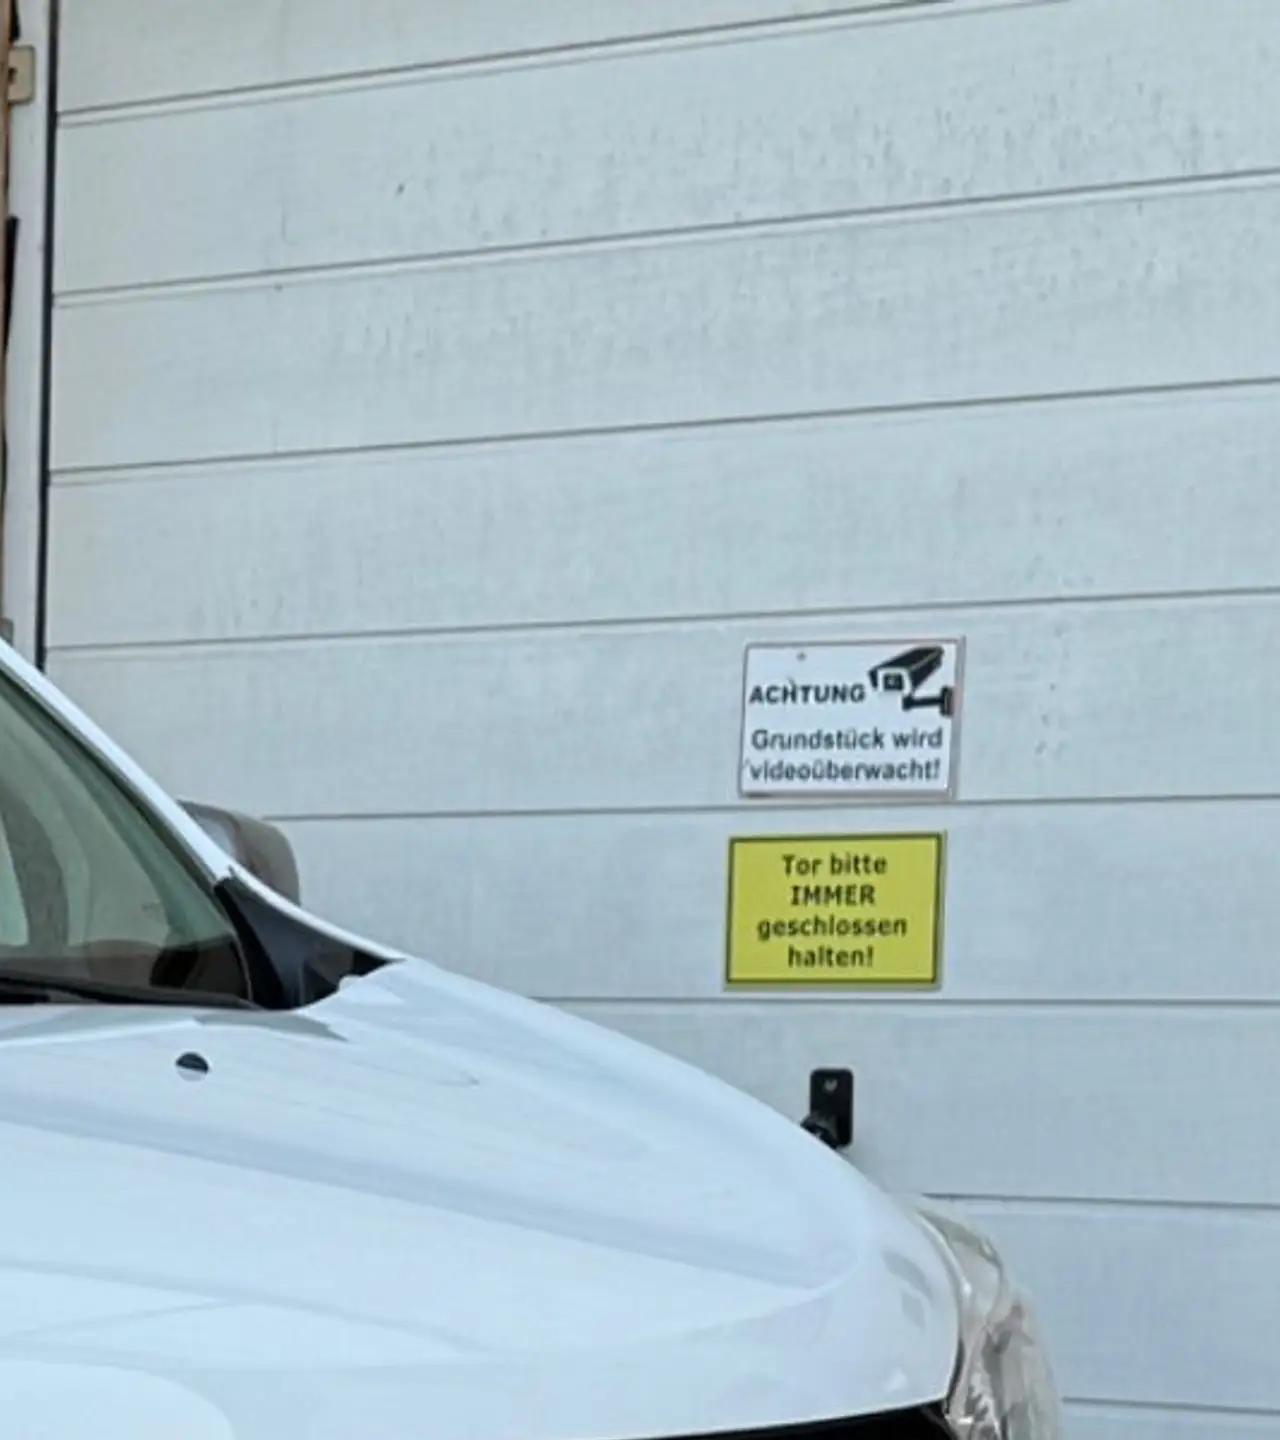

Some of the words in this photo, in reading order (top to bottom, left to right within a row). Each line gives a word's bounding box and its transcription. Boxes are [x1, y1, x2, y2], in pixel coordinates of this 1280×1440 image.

[749, 684, 866, 706] ACHTUNG
[752, 728, 885, 752] Grundstück
[892, 727, 943, 749] wird
[749, 758, 940, 782] videoüberwacht!
[782, 854, 823, 876] Tor
[830, 852, 887, 875] bitte
[790, 884, 876, 907] IMMER
[757, 915, 908, 942] geschlossen
[788, 946, 874, 968] halten!
